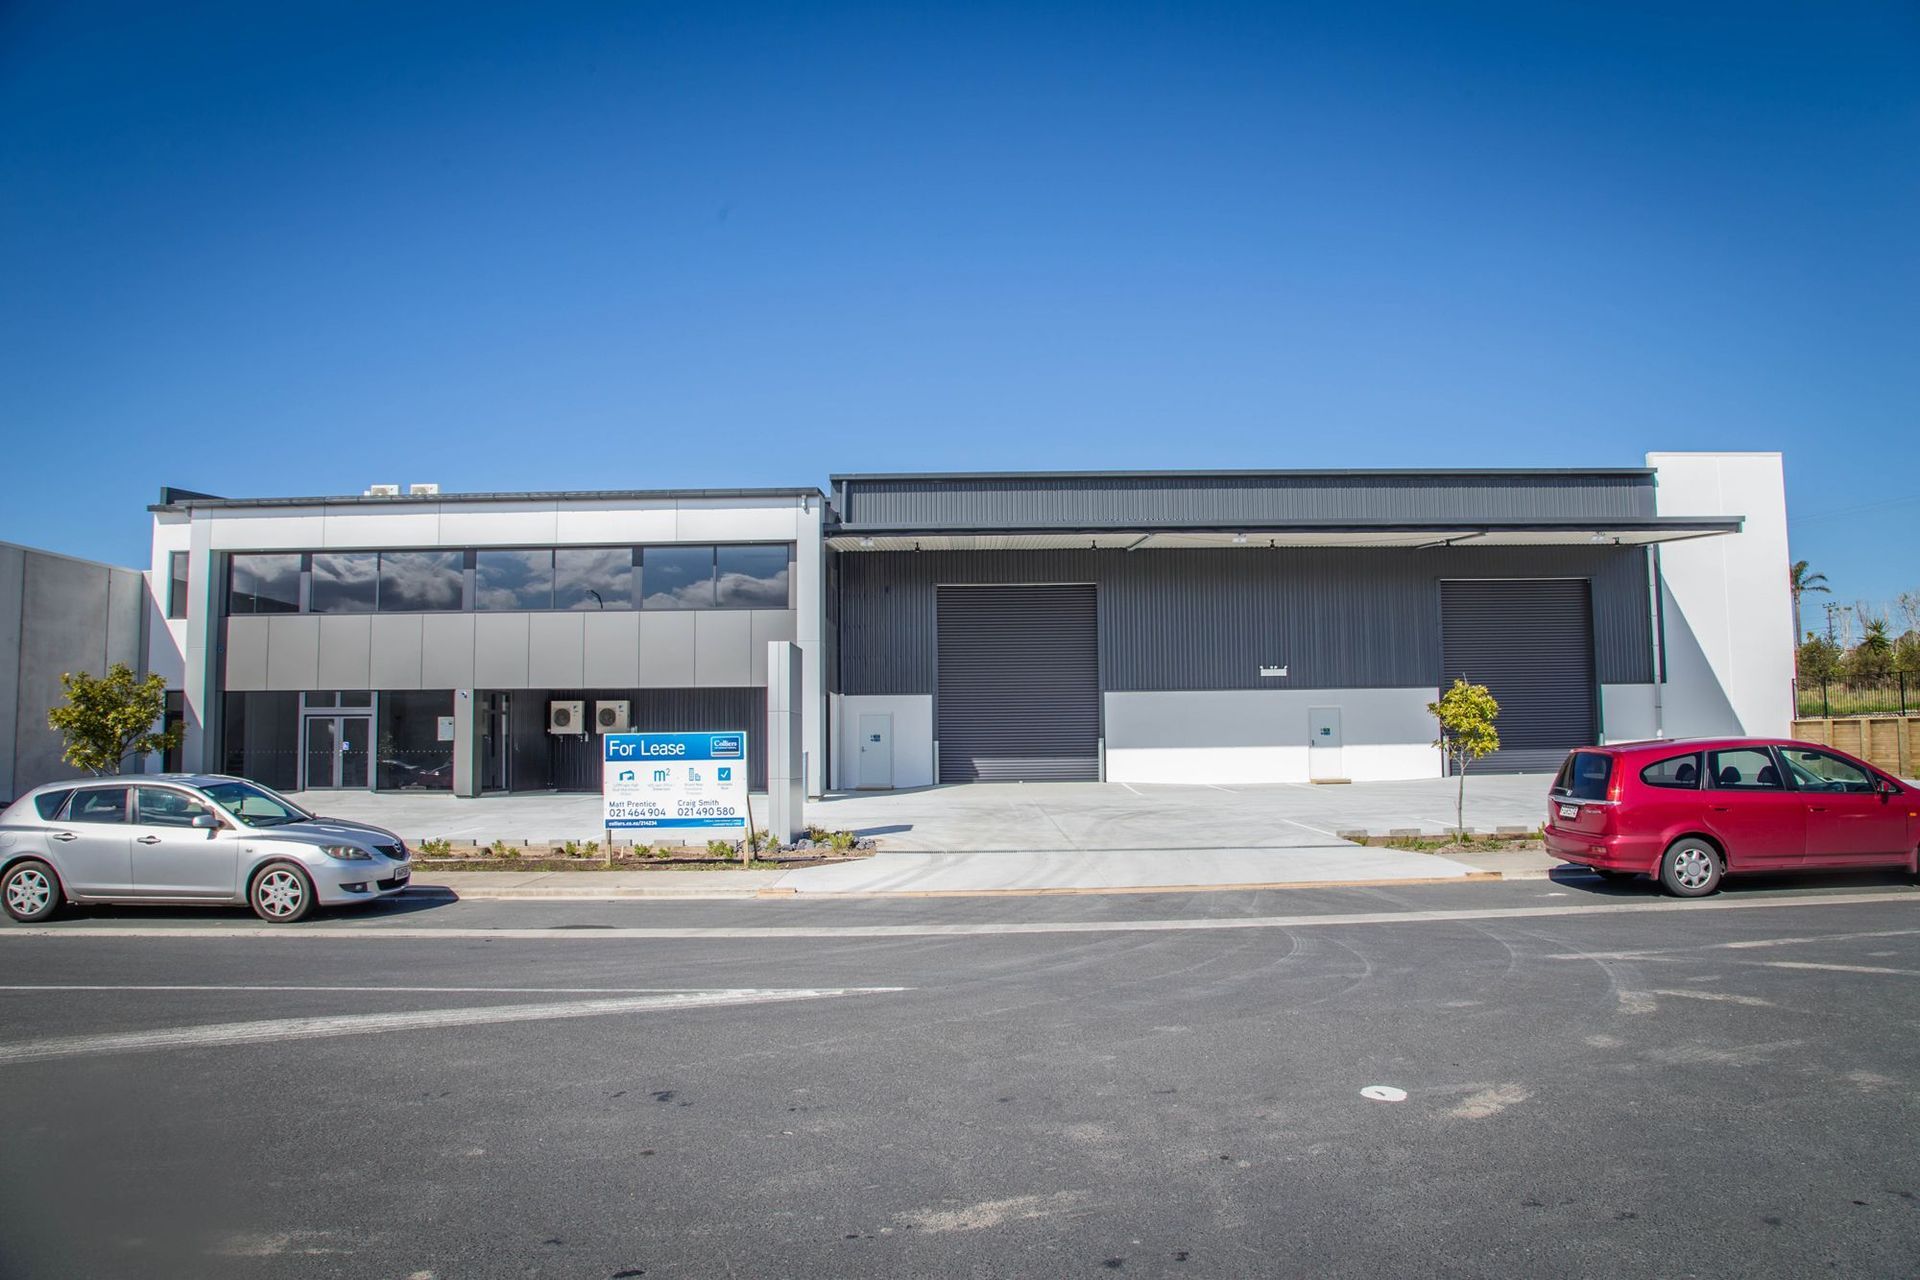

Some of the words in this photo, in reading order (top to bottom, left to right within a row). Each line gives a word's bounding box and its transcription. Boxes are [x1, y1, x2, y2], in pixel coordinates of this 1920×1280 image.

[609, 740, 636, 757] For
[641, 739, 686, 756] Lease
[627, 800, 657, 808] Prentice
[677, 799, 696, 808] Craig
[609, 808, 626, 817] 021
[628, 808, 646, 817] 464
[647, 808, 666, 817] 904
[677, 807, 694, 816] 021
[696, 807, 715, 816] 490
[716, 807, 735, 816] 580
